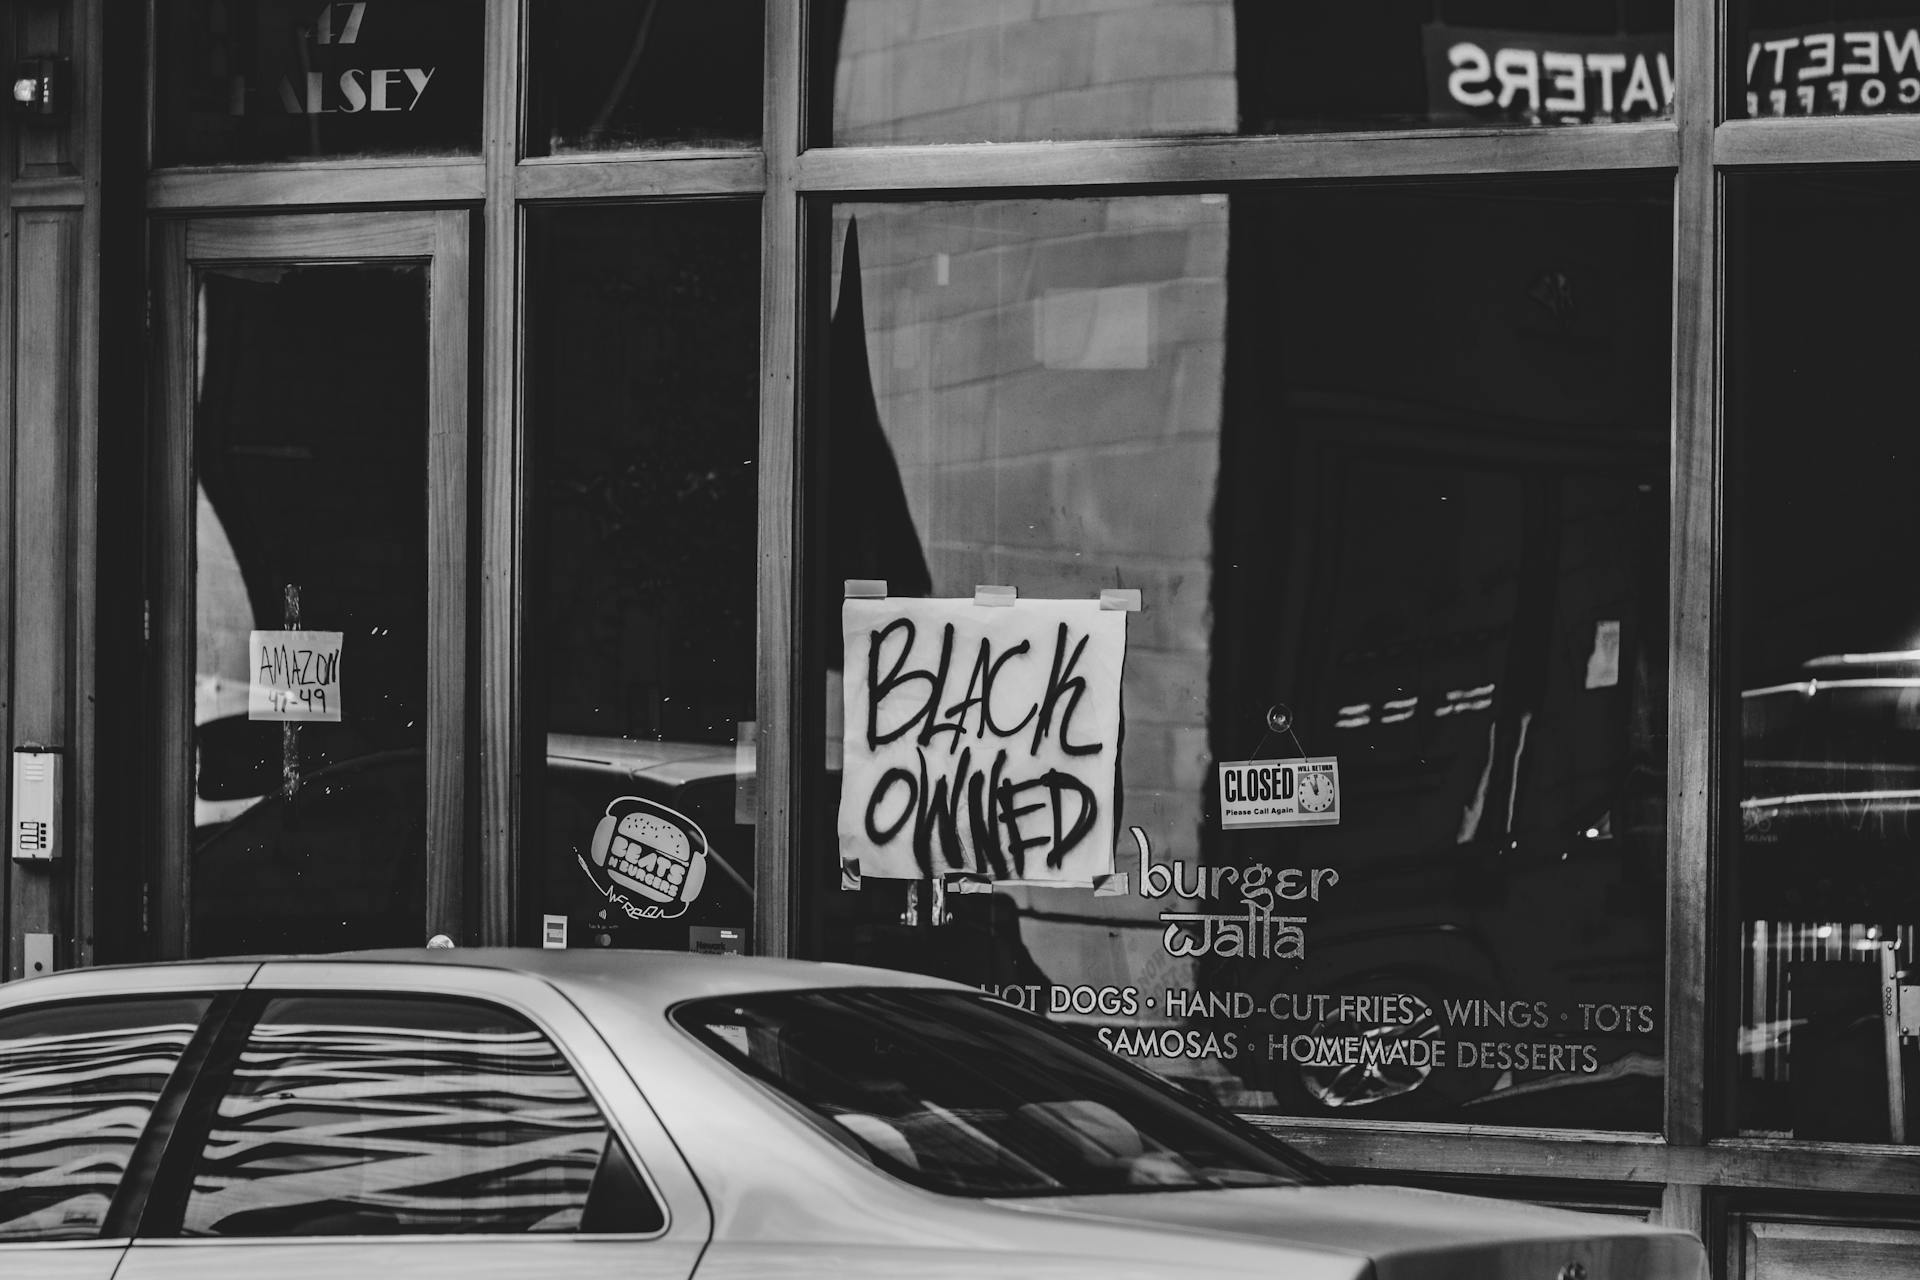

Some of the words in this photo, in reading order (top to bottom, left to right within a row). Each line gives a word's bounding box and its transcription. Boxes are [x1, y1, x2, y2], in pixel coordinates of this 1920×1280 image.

[304, 2, 367, 44] 47
[259, 643, 340, 688] AMAZON
[866, 618, 1103, 756] BLACK
[268, 688, 327, 714] 47-49
[1224, 767, 1294, 802] CLOSED
[864, 746, 1099, 880] OWNED
[1271, 807, 1294, 816] Again
[611, 835, 686, 886] BEATS
[1129, 826, 1340, 912] burger
[1159, 899, 1307, 960] walla
[1050, 985, 1138, 1016] DOGS
[1165, 989, 1330, 1021] HAND-CUT
[1339, 994, 1414, 1025] FRIES
[1443, 999, 1549, 1029] WINGS
[1578, 1003, 1655, 1033] TOTS
[1097, 1027, 1238, 1060] SAMOSAS
[1268, 1033, 1446, 1067] HOMEMADE
[1457, 1040, 1599, 1073] DESSERTS
